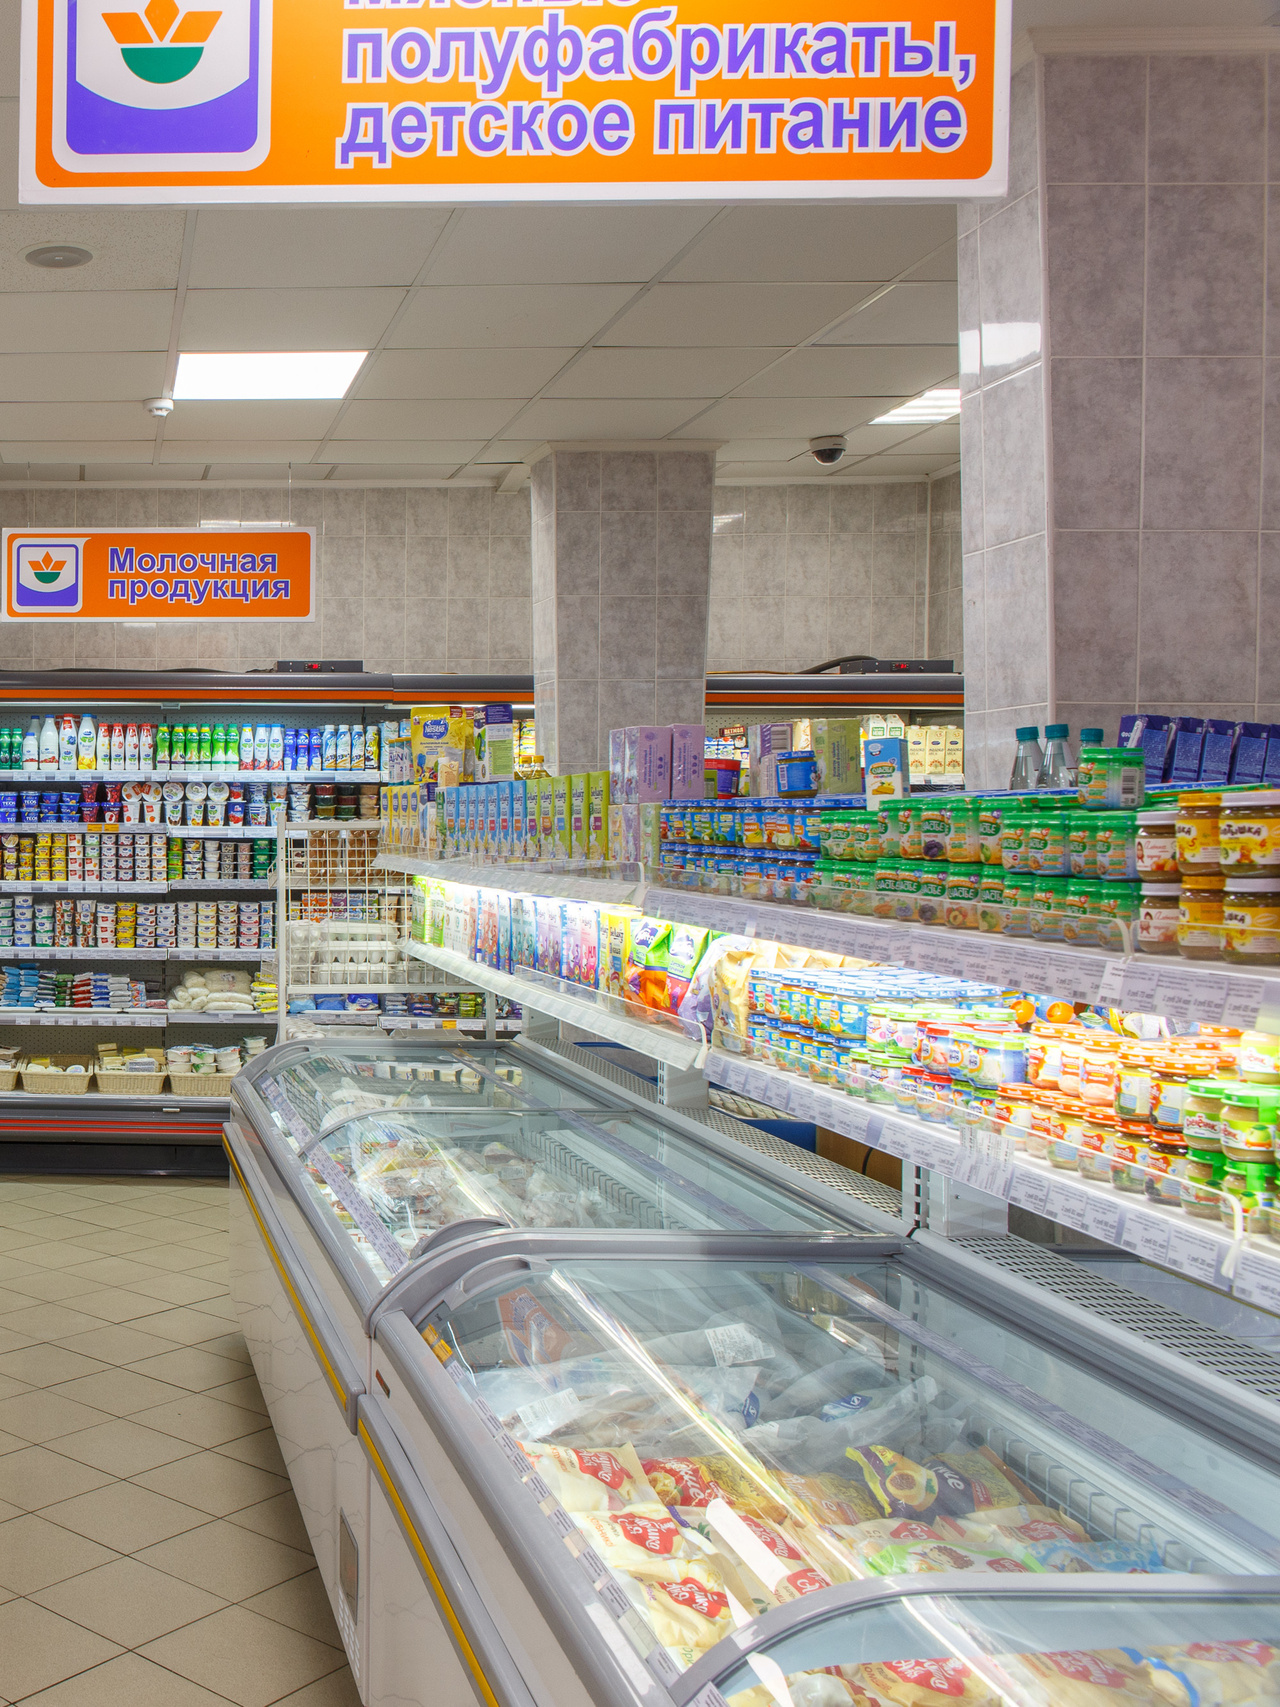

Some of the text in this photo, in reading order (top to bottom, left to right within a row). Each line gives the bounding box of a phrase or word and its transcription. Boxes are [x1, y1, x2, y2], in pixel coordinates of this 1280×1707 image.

[344, 10, 974, 98] полуфабрикаты,
[336, 96, 967, 168] детское питание
[108, 547, 277, 573] Молочная
[108, 578, 291, 605] продукция
